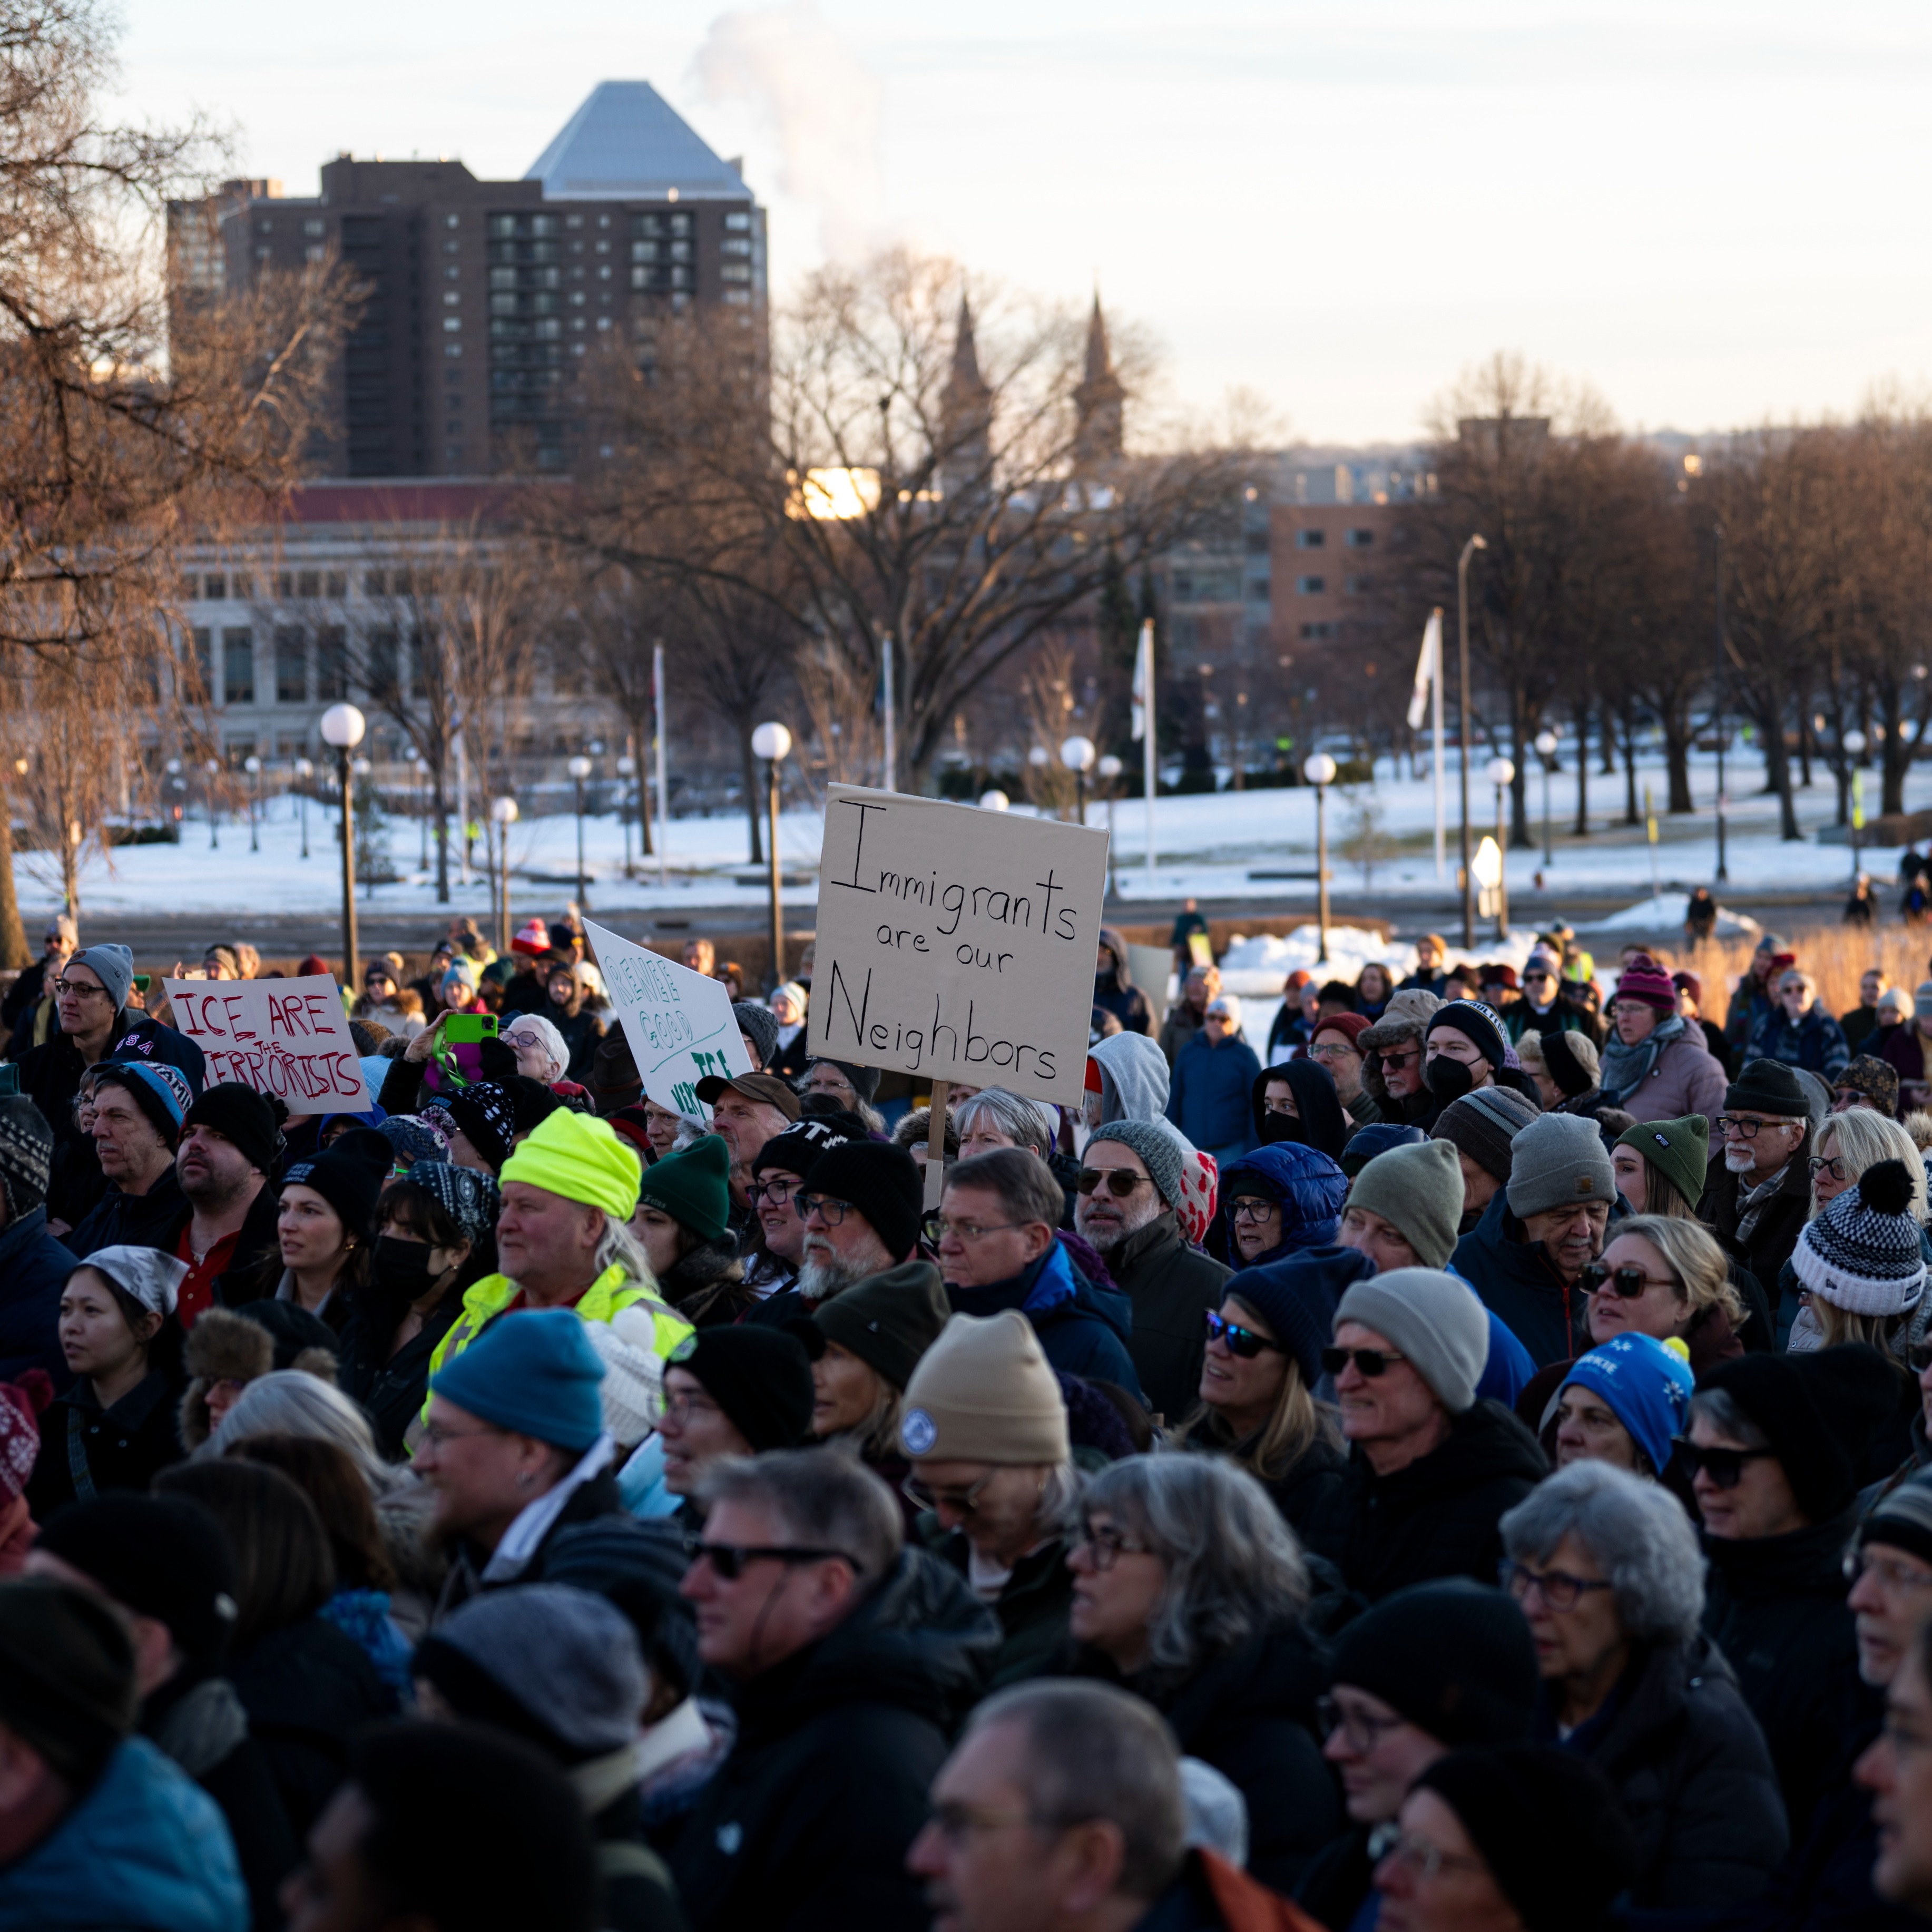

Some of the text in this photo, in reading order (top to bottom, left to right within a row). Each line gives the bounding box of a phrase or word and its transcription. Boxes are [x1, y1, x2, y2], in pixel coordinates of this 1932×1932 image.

[831, 800, 1077, 940] Immigrants
[877, 925, 1014, 973] are our
[605, 956, 680, 1007] RENEE
[173, 993, 336, 1042] ICE ARE
[639, 1011, 693, 1050] GOOD
[826, 959, 1056, 1080] Neighbors
[252, 1041, 286, 1055] THE
